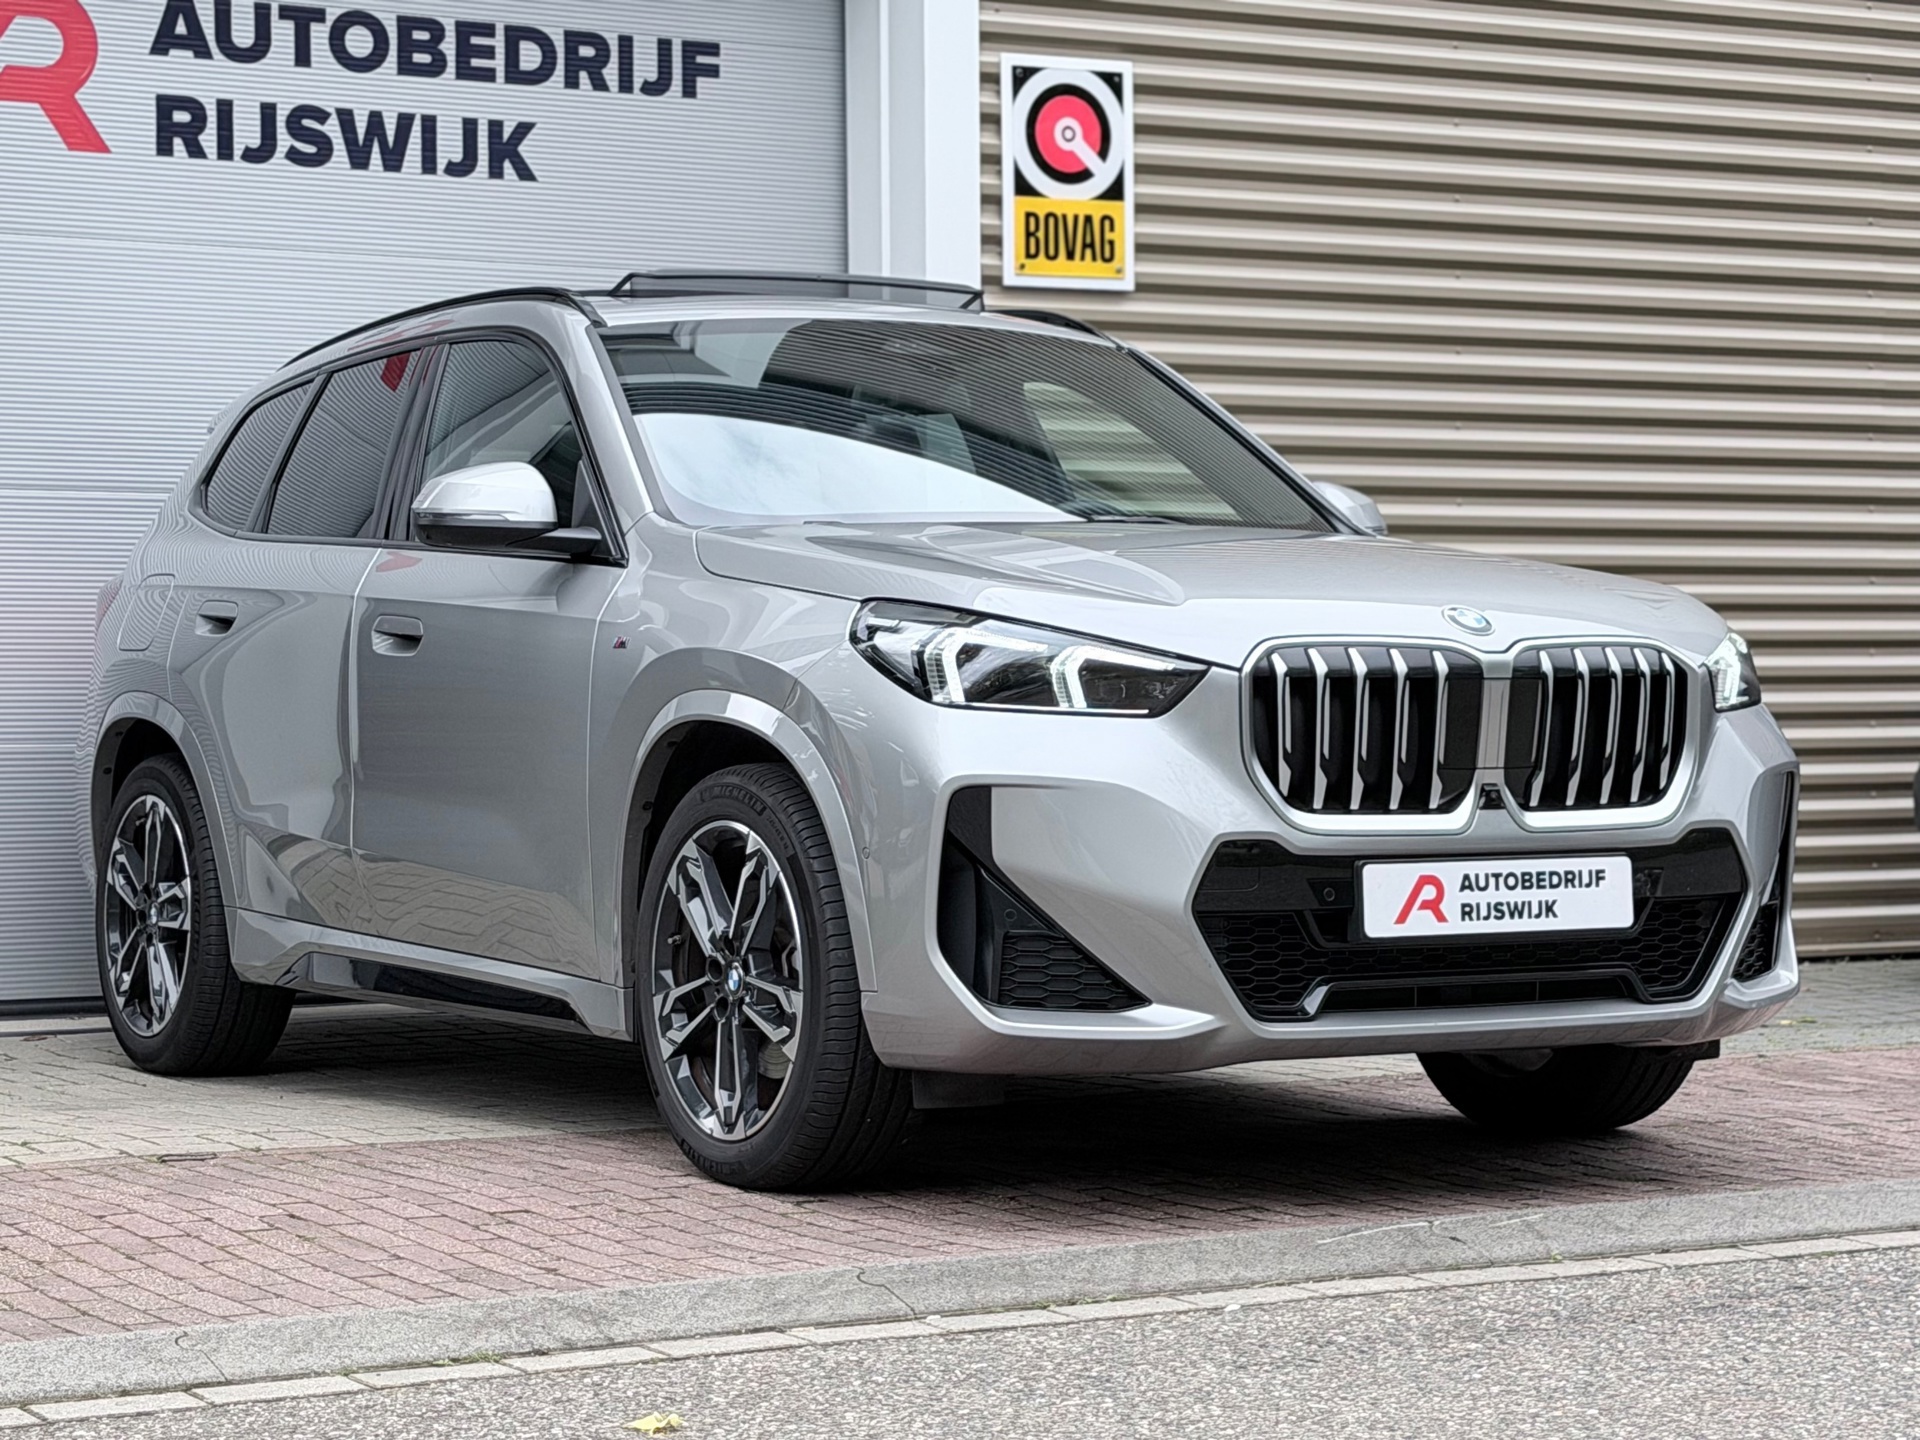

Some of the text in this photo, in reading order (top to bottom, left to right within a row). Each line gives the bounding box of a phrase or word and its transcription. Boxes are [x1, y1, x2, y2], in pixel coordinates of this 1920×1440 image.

[149, 0, 721, 99] AUTOBEDRIJF
[155, 94, 539, 182] RIJSWIJK
[1024, 211, 1116, 263] BOVAG
[712, 785, 764, 813] MICHELIN
[1458, 869, 1606, 893] AUTOBEDRIJF
[1460, 899, 1558, 922] RIJSWIJK
